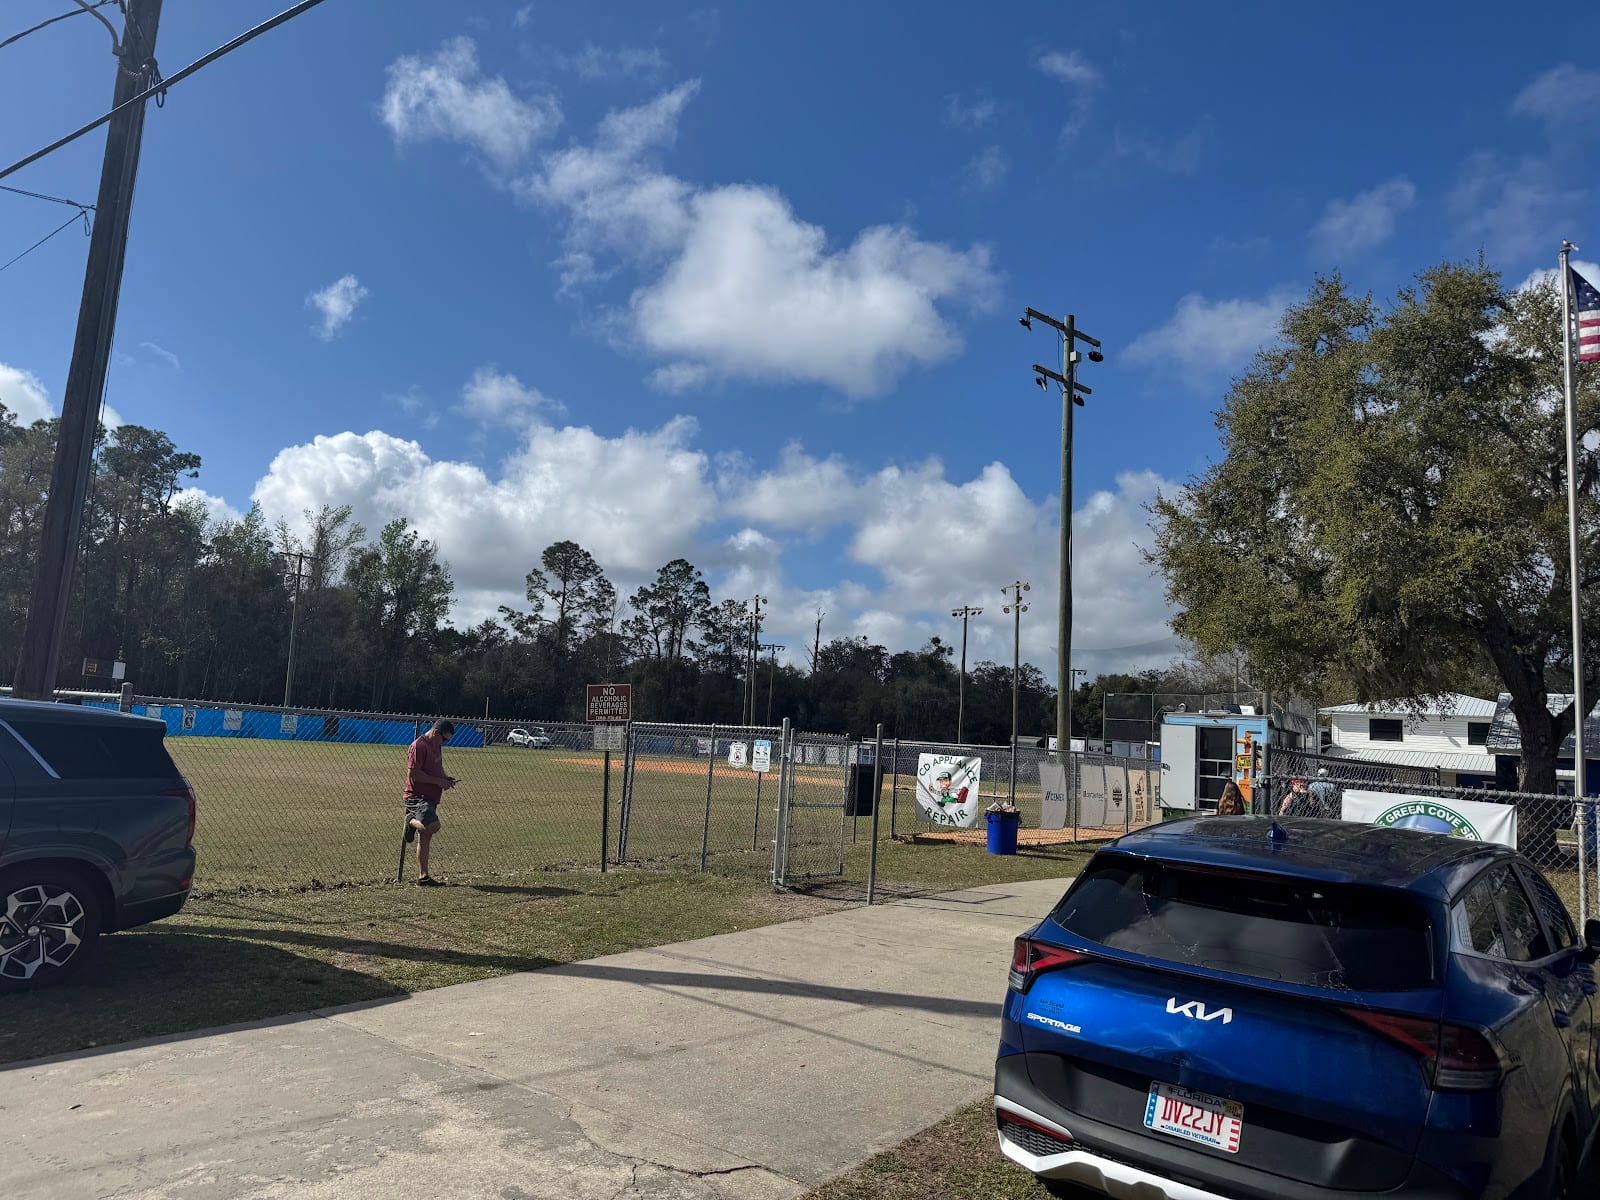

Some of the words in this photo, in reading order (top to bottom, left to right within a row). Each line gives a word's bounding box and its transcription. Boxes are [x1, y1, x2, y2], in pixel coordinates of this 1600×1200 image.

[602, 687, 616, 696] NO
[919, 764, 930, 776] CD
[932, 756, 978, 784] APPLIANCE
[924, 807, 968, 824] REPAIR
[1386, 805, 1424, 823] GREEN
[1428, 806, 1462, 827] COVE
[1166, 996, 1233, 1025] KIA
[1026, 1012, 1081, 1033] SPORTAGE
[1170, 1086, 1222, 1107] FLORIDA
[1161, 1097, 1225, 1136] DV22JY
[1164, 1124, 1190, 1136] DISABLED
[1192, 1132, 1216, 1144] VETERAN
